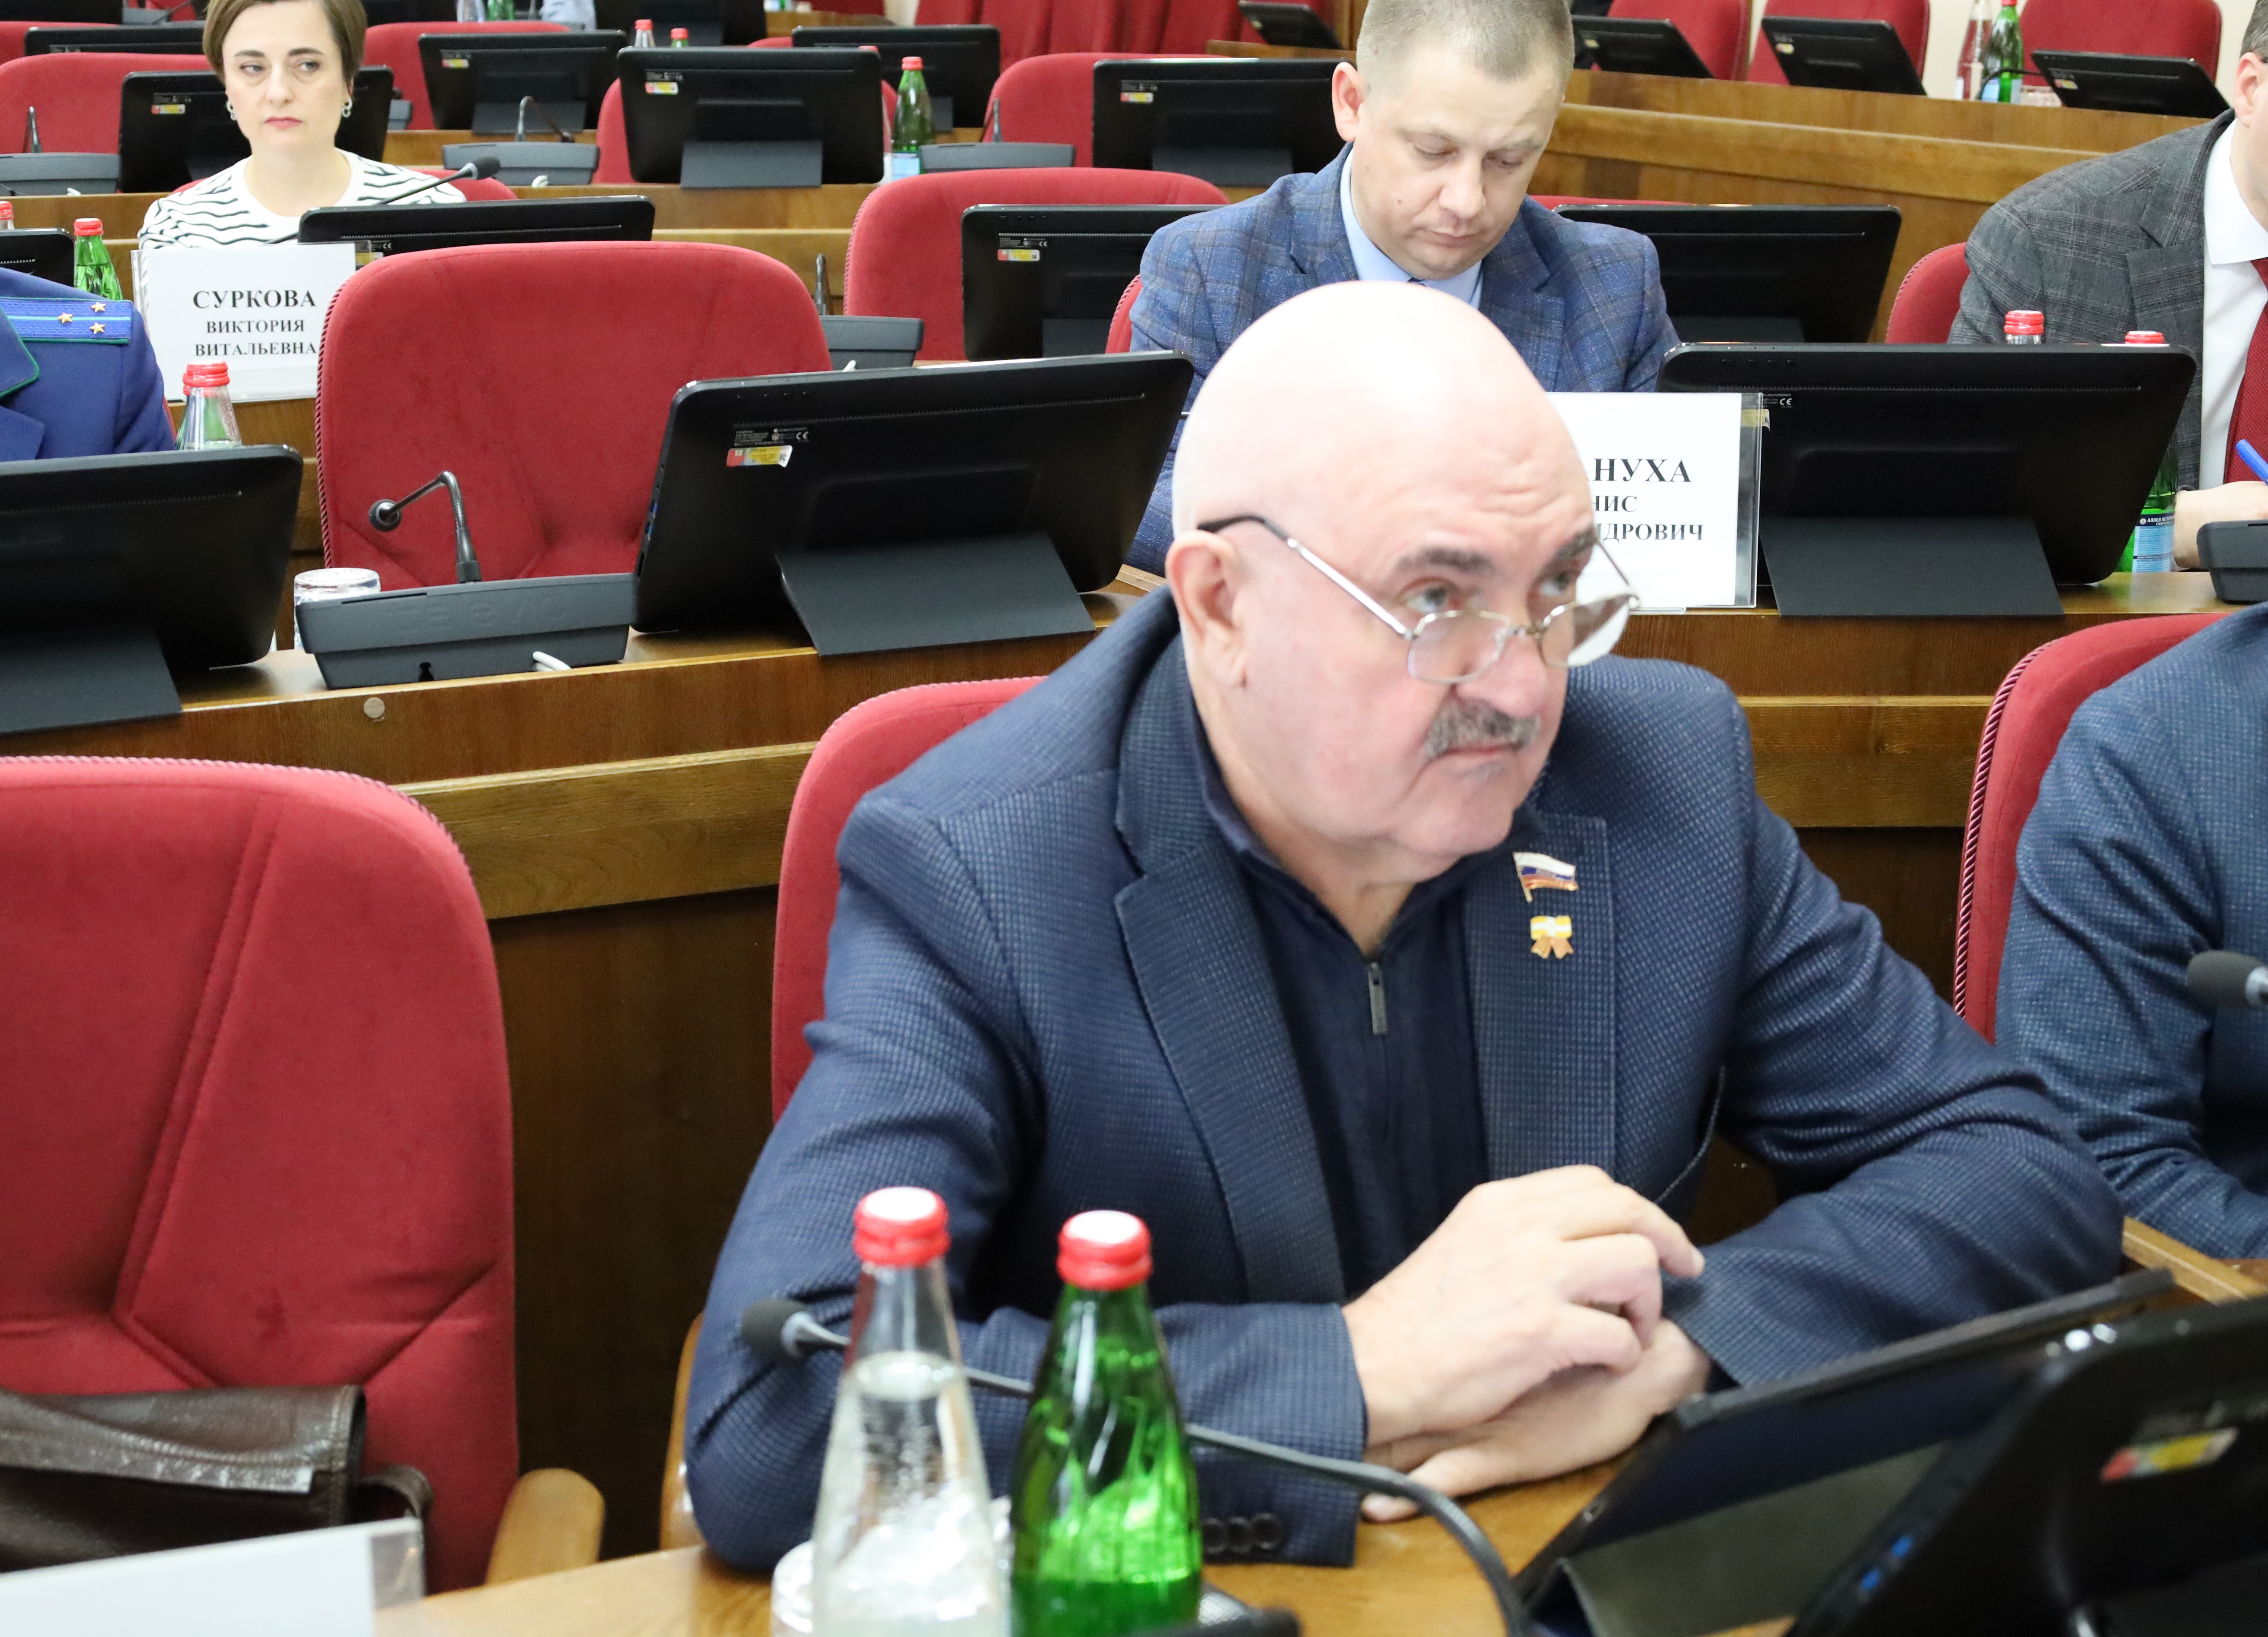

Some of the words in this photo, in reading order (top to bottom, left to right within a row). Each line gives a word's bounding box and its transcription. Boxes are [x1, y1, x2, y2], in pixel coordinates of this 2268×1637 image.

[193, 290, 317, 308] СУРКОВА
[206, 320, 305, 333] ВИКТОРИЯ
[195, 342, 316, 356] ВИТАЛЬЕВНА
[1587, 458, 1692, 482] НУХА
